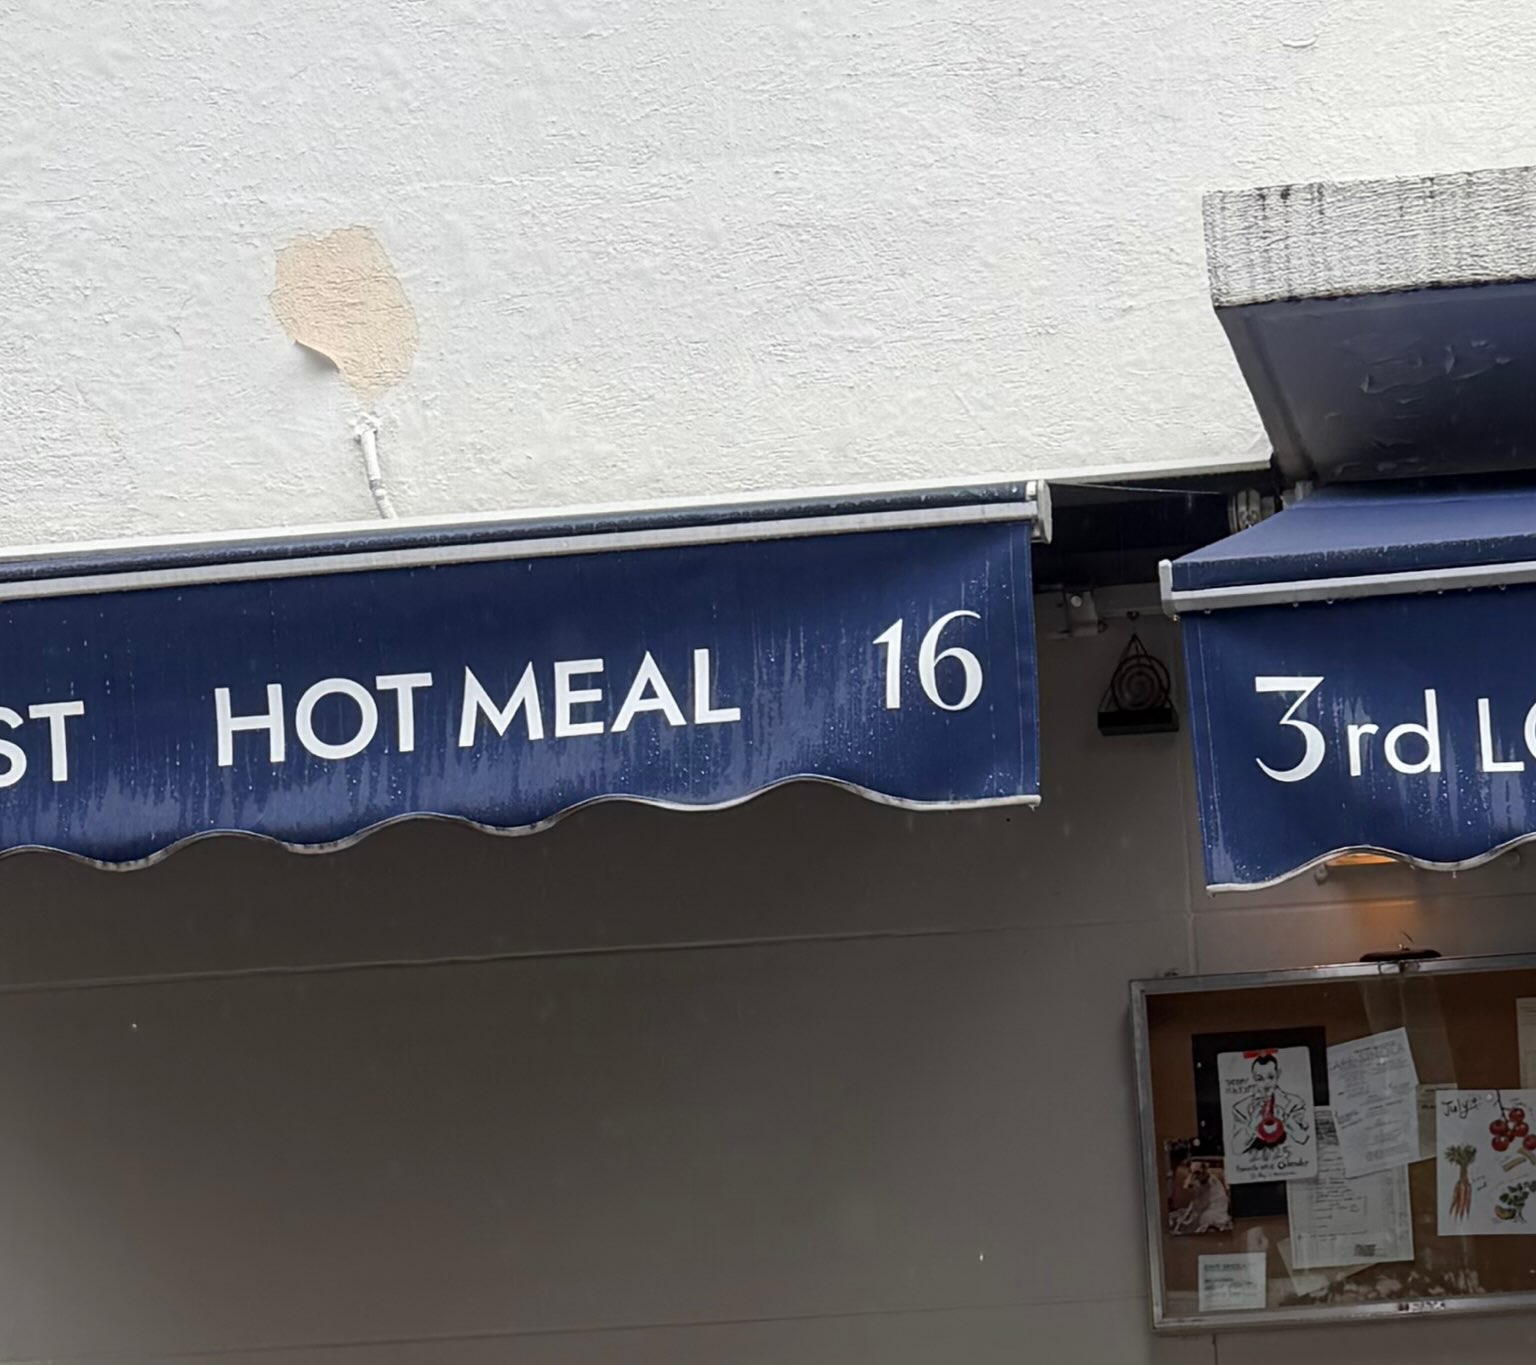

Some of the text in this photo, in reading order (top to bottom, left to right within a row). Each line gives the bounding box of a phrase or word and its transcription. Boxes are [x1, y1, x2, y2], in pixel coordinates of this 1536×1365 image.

[215, 662, 432, 766] HOT
[459, 649, 740, 746] MEAL
[874, 611, 982, 710] 16
[1256, 677, 1440, 781] 3rd
